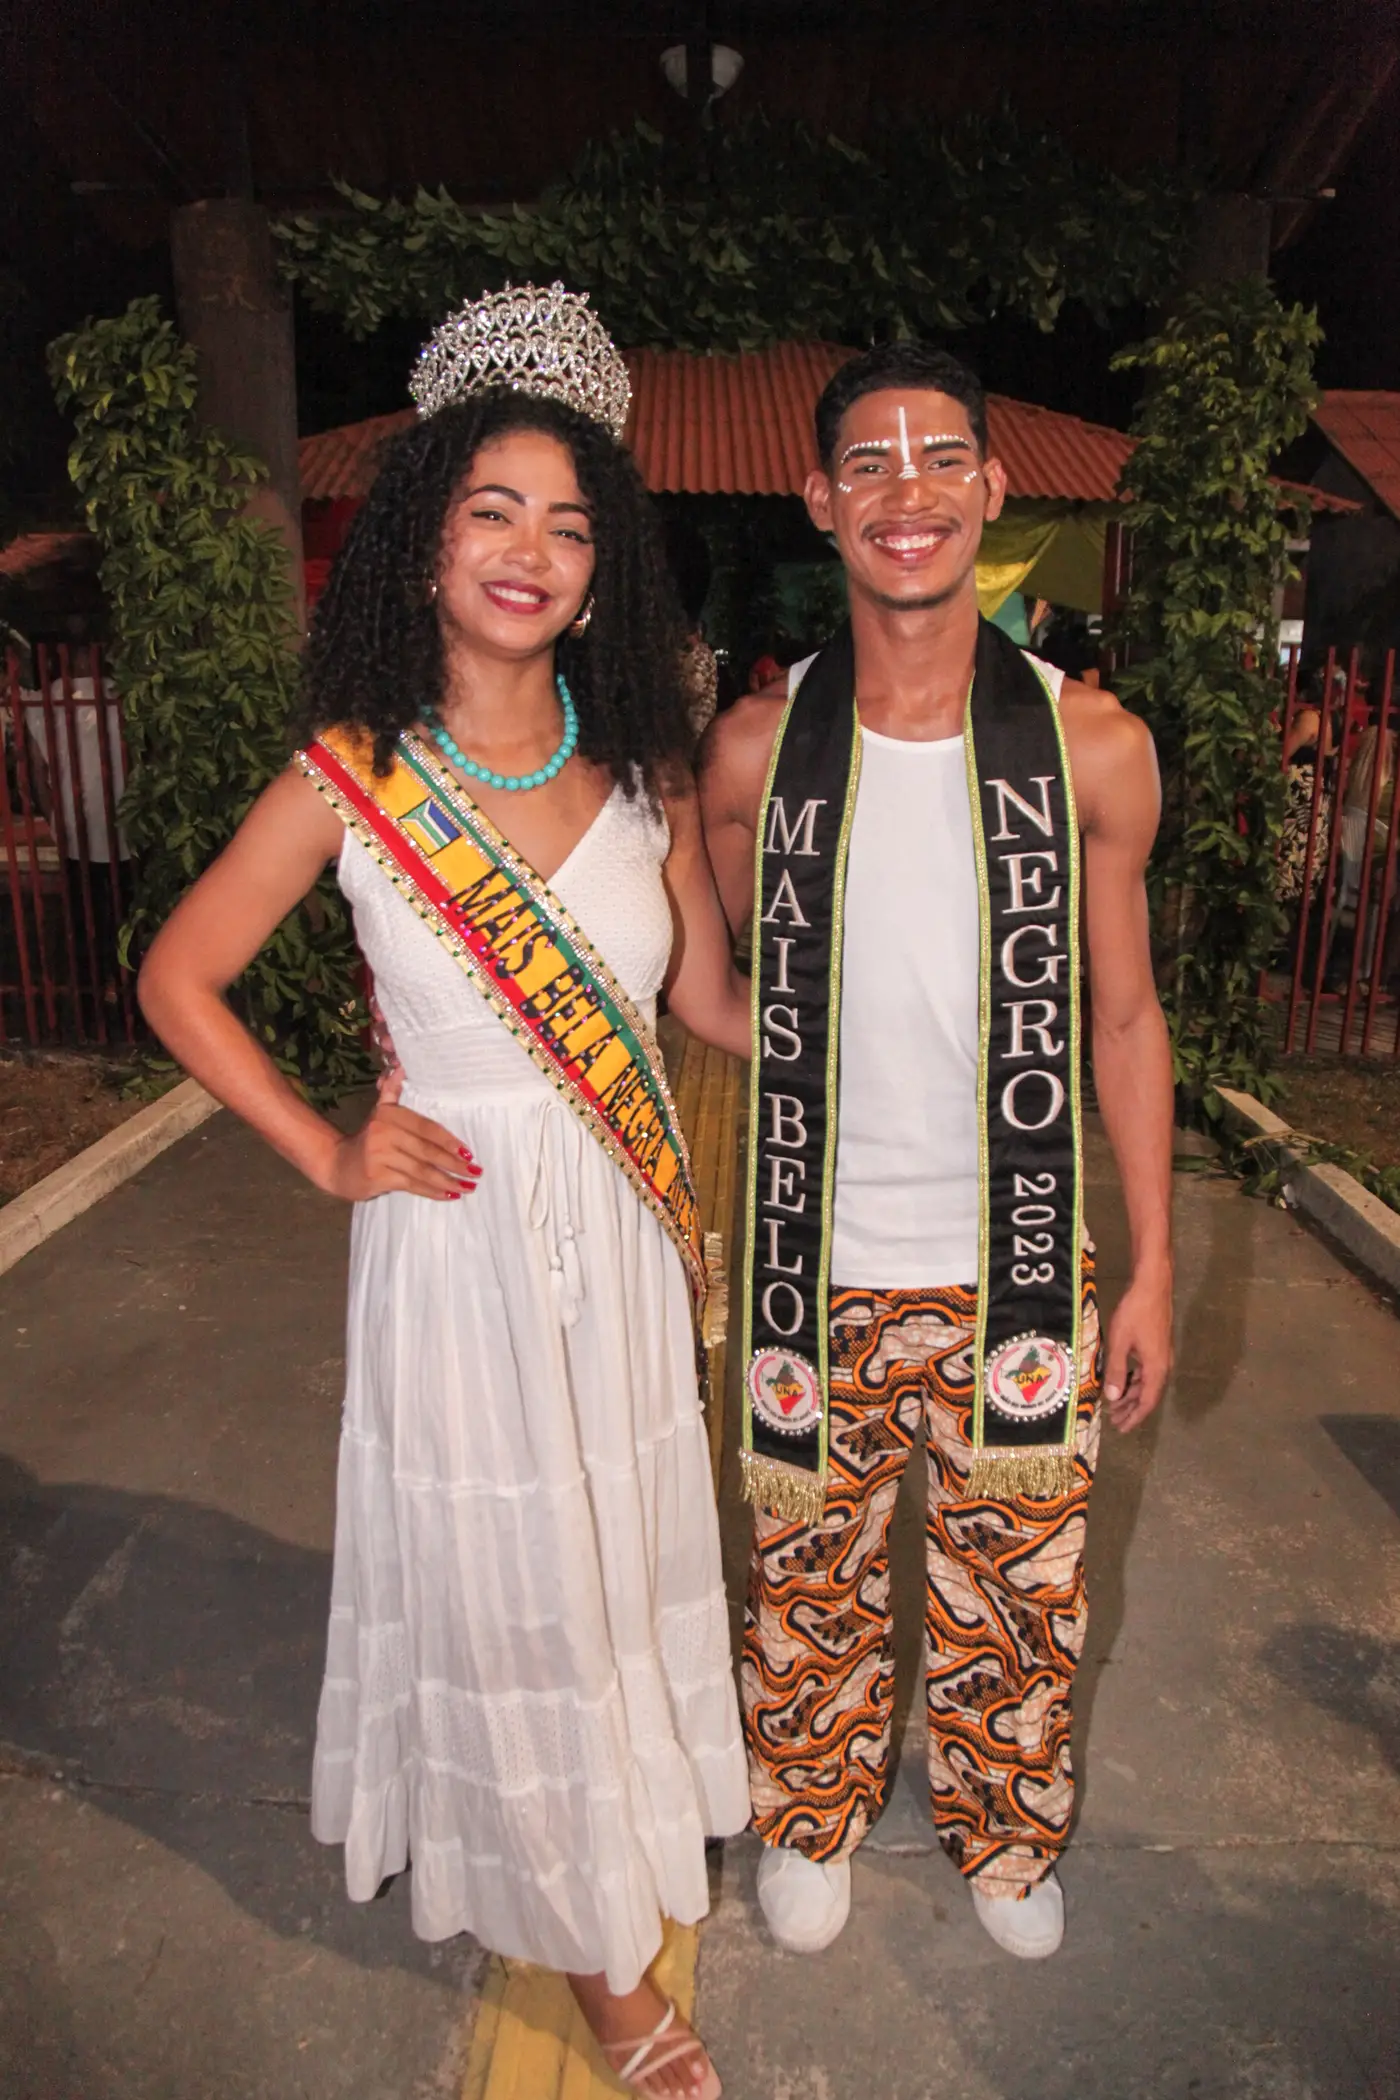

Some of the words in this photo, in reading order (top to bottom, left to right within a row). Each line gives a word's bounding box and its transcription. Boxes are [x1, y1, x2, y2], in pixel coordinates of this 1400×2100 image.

[443, 863, 557, 979] MAIS
[519, 962, 623, 1082] BELA
[593, 1054, 669, 1187] NEGRA
[761, 797, 828, 1061] MAIS
[985, 776, 1067, 1130] NEGRO
[762, 1092, 807, 1337] BELO
[1011, 1173, 1057, 1286] 2023
